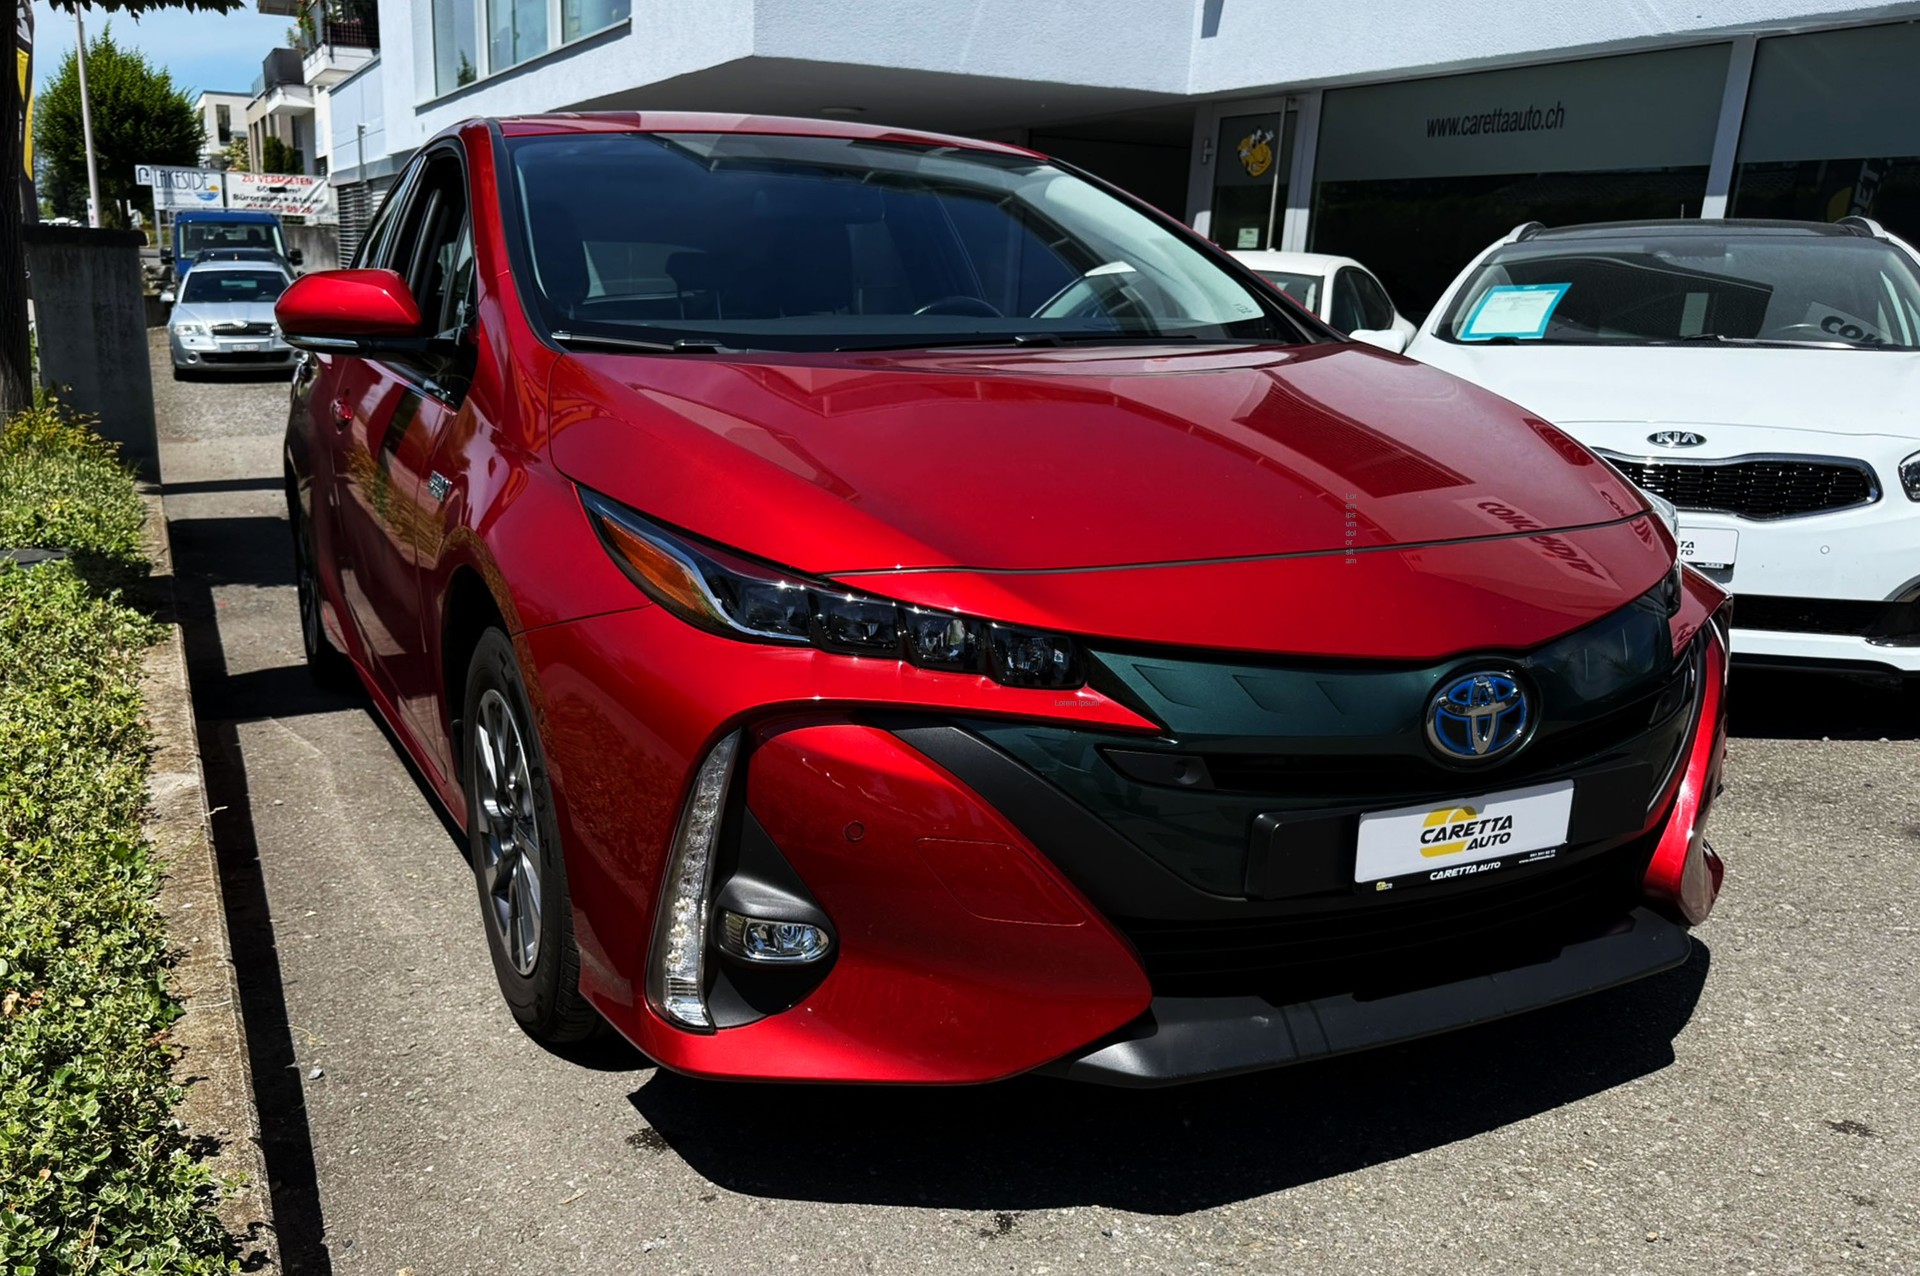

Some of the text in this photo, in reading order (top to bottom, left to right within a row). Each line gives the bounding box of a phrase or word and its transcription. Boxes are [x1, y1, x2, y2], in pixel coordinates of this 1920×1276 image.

[1426, 100, 1565, 138] www.carettaauto.ch
[153, 170, 209, 191] LAKESIDE
[1656, 432, 1698, 444] KIA
[1420, 815, 1513, 844] CARETTA
[1466, 832, 1511, 851] AUTO
[1429, 861, 1501, 881] CARETTA AUTO
